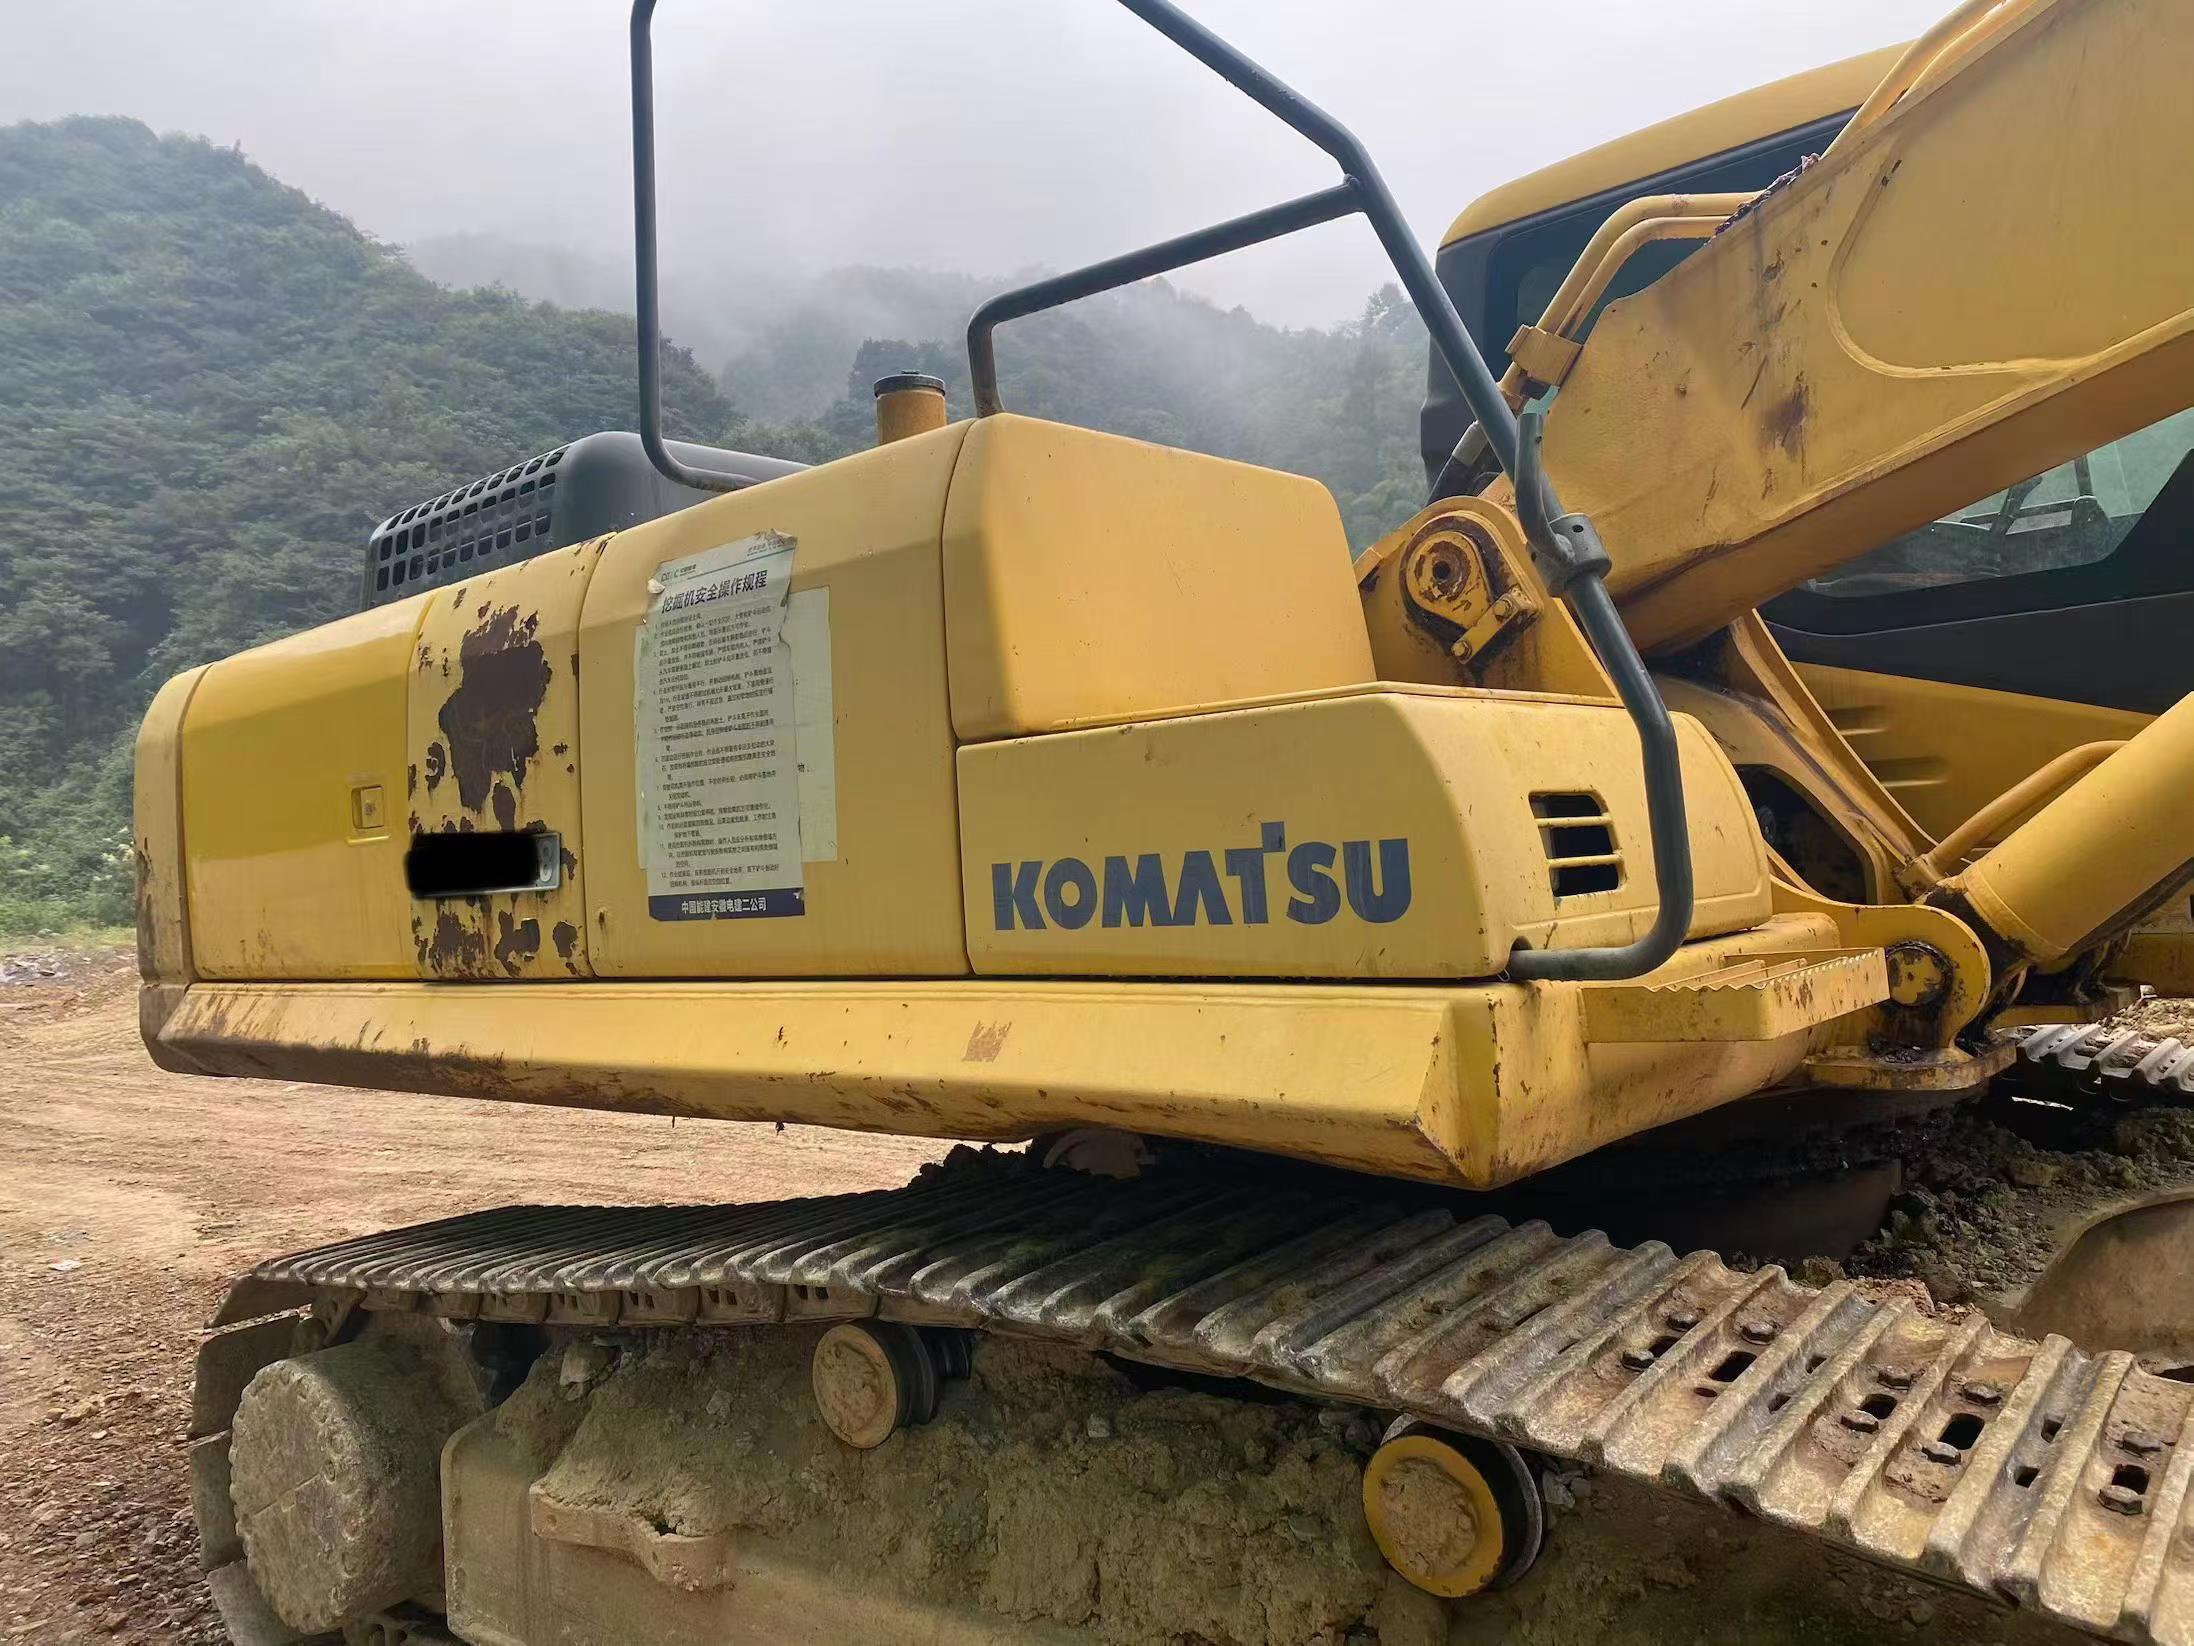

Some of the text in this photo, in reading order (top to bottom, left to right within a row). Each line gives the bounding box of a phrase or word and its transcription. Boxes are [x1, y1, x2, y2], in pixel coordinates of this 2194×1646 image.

[662, 570, 768, 614] 挖掘机安全操作规程
[991, 821, 1412, 931] KOMATSU
[681, 897, 767, 914] 中国能建安徽电建二公司
